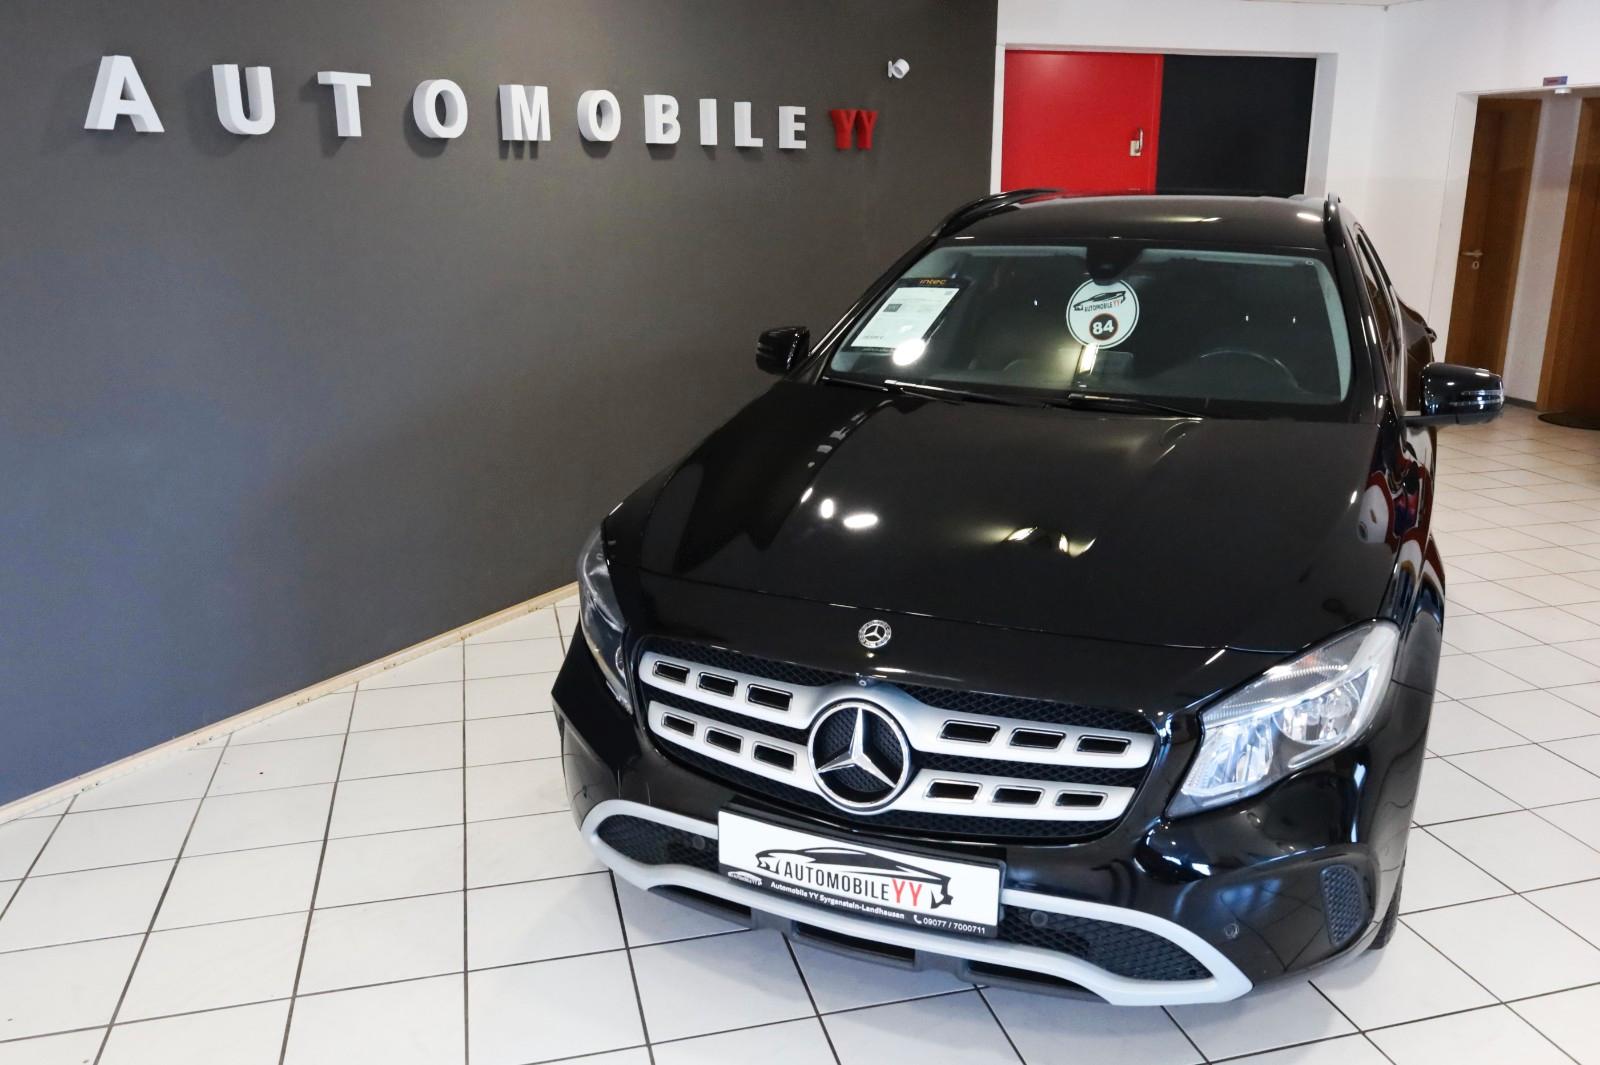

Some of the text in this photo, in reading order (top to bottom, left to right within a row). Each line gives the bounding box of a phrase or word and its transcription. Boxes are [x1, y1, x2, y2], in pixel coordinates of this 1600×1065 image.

[84, 55, 878, 150] AUTOMOBILE YY
[1092, 319, 1114, 335] 84
[770, 881, 808, 898] Automobile
[809, 891, 819, 900] YY
[923, 917, 947, 928] 09077
[953, 922, 986, 934] 7000711
